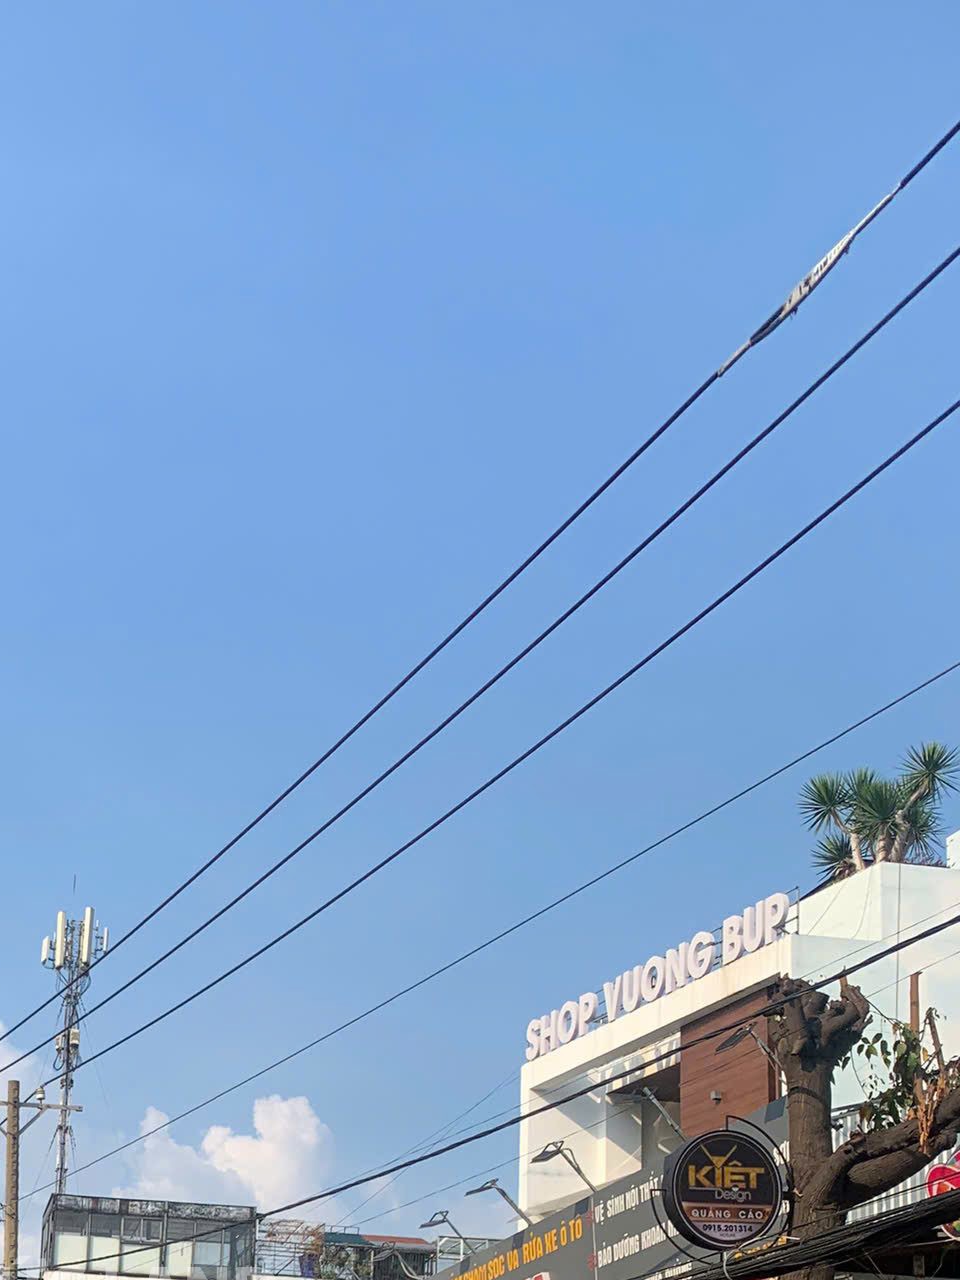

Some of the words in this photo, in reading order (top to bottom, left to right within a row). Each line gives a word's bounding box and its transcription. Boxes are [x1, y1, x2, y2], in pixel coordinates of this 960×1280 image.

[526, 992, 598, 1061] SHOP
[603, 931, 716, 1023] VUONG
[722, 892, 790, 966] BUP
[607, 1190, 626, 1219] SINH
[715, 1188, 751, 1202] Design
[544, 1226, 559, 1254] XE
[560, 1221, 568, 1246] Ô
[702, 1224, 753, 1232] 0915.201314
